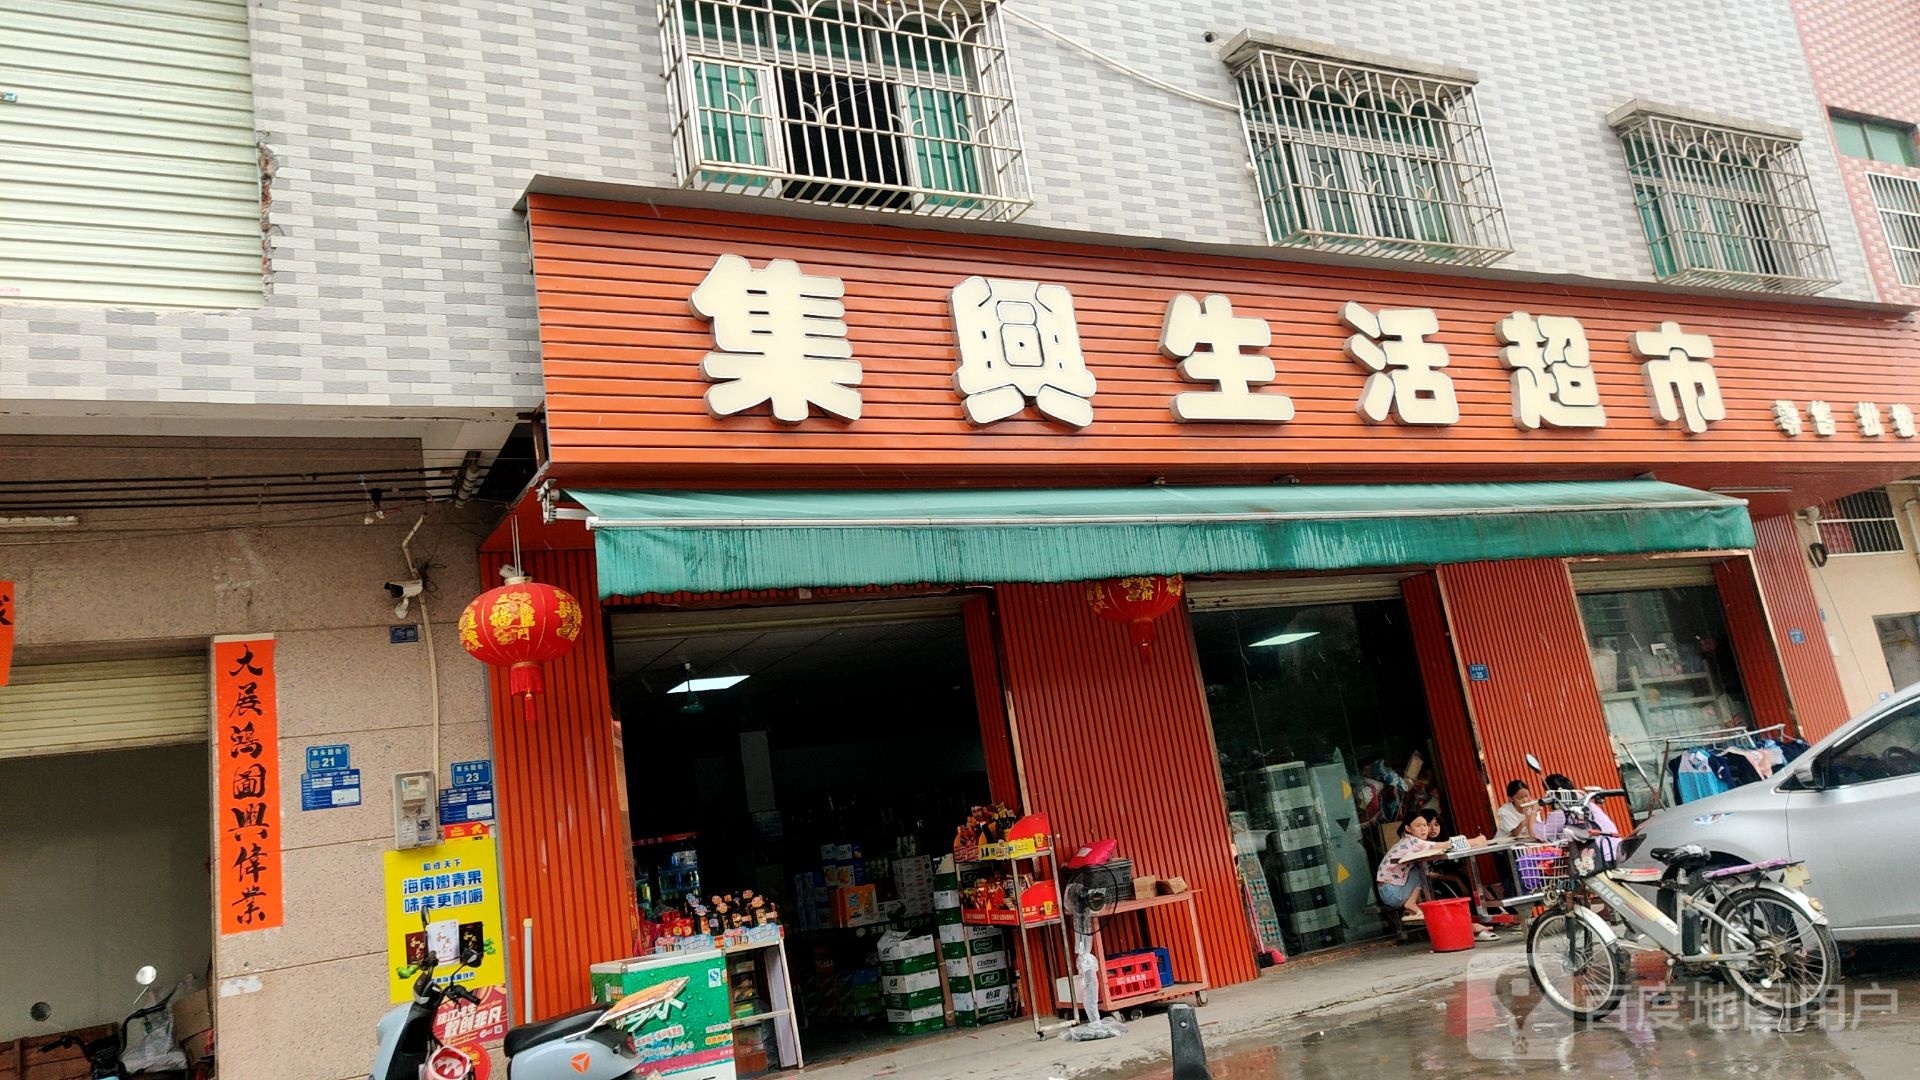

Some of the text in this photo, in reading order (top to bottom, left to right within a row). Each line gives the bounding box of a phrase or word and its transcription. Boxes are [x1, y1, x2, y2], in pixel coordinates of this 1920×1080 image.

[689, 254, 1727, 434] 集興生活超市
[322, 757, 335, 767] 21
[466, 773, 479, 783] 23
[404, 870, 482, 894] 海南嫩青果
[404, 888, 483, 913] 味美更耐嚼
